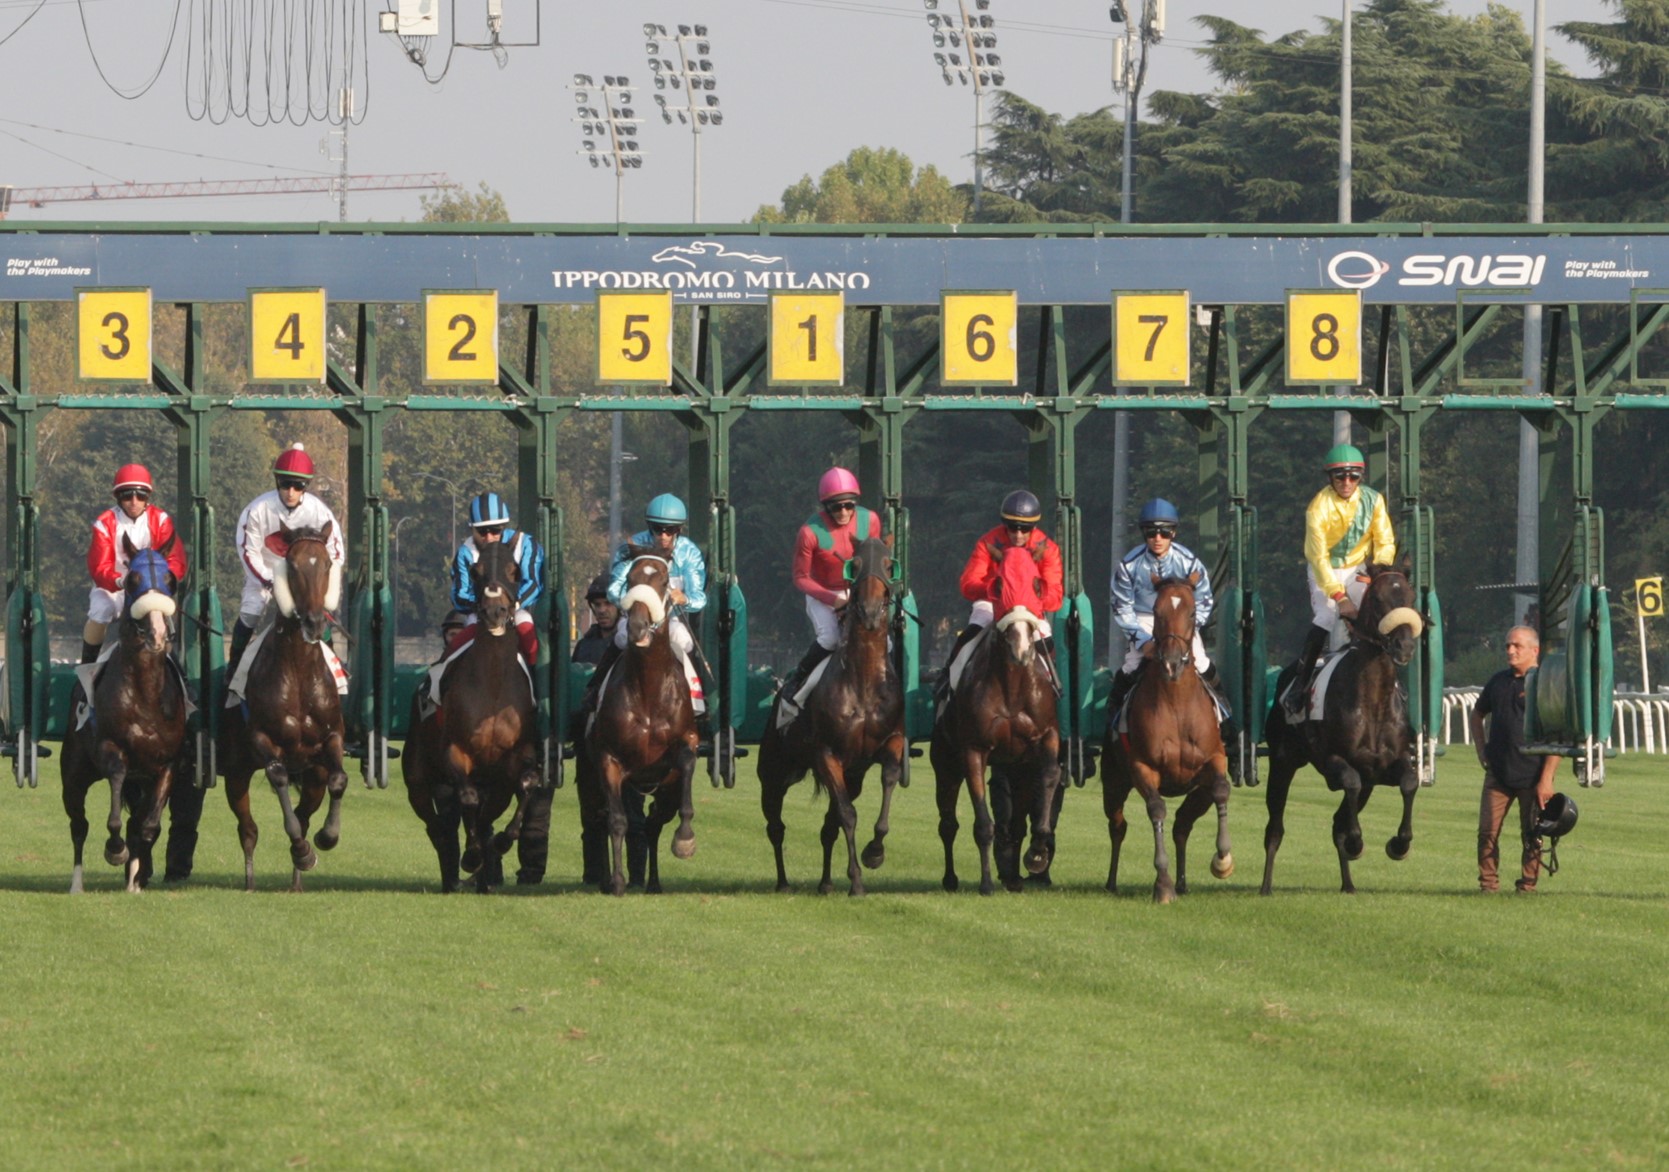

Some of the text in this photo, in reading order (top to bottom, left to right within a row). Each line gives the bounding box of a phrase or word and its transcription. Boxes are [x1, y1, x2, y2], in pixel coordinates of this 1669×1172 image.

[7, 257, 59, 269] Play with
[7, 266, 92, 277] the Playmakers
[551, 270, 871, 289] IPPODROMO MILANO
[1565, 260, 1617, 271] Play with
[1565, 268, 1650, 279] the Playmakers
[690, 291, 742, 300] SAN SIRO
[101, 312, 131, 360] 3
[274, 312, 305, 360] 4
[447, 314, 477, 361] 2
[621, 314, 652, 362] 5
[798, 314, 817, 362] 1
[965, 314, 995, 362] 6
[1137, 314, 1169, 361] 7
[1309, 313, 1340, 361] 8
[1639, 581, 1661, 613] 6
